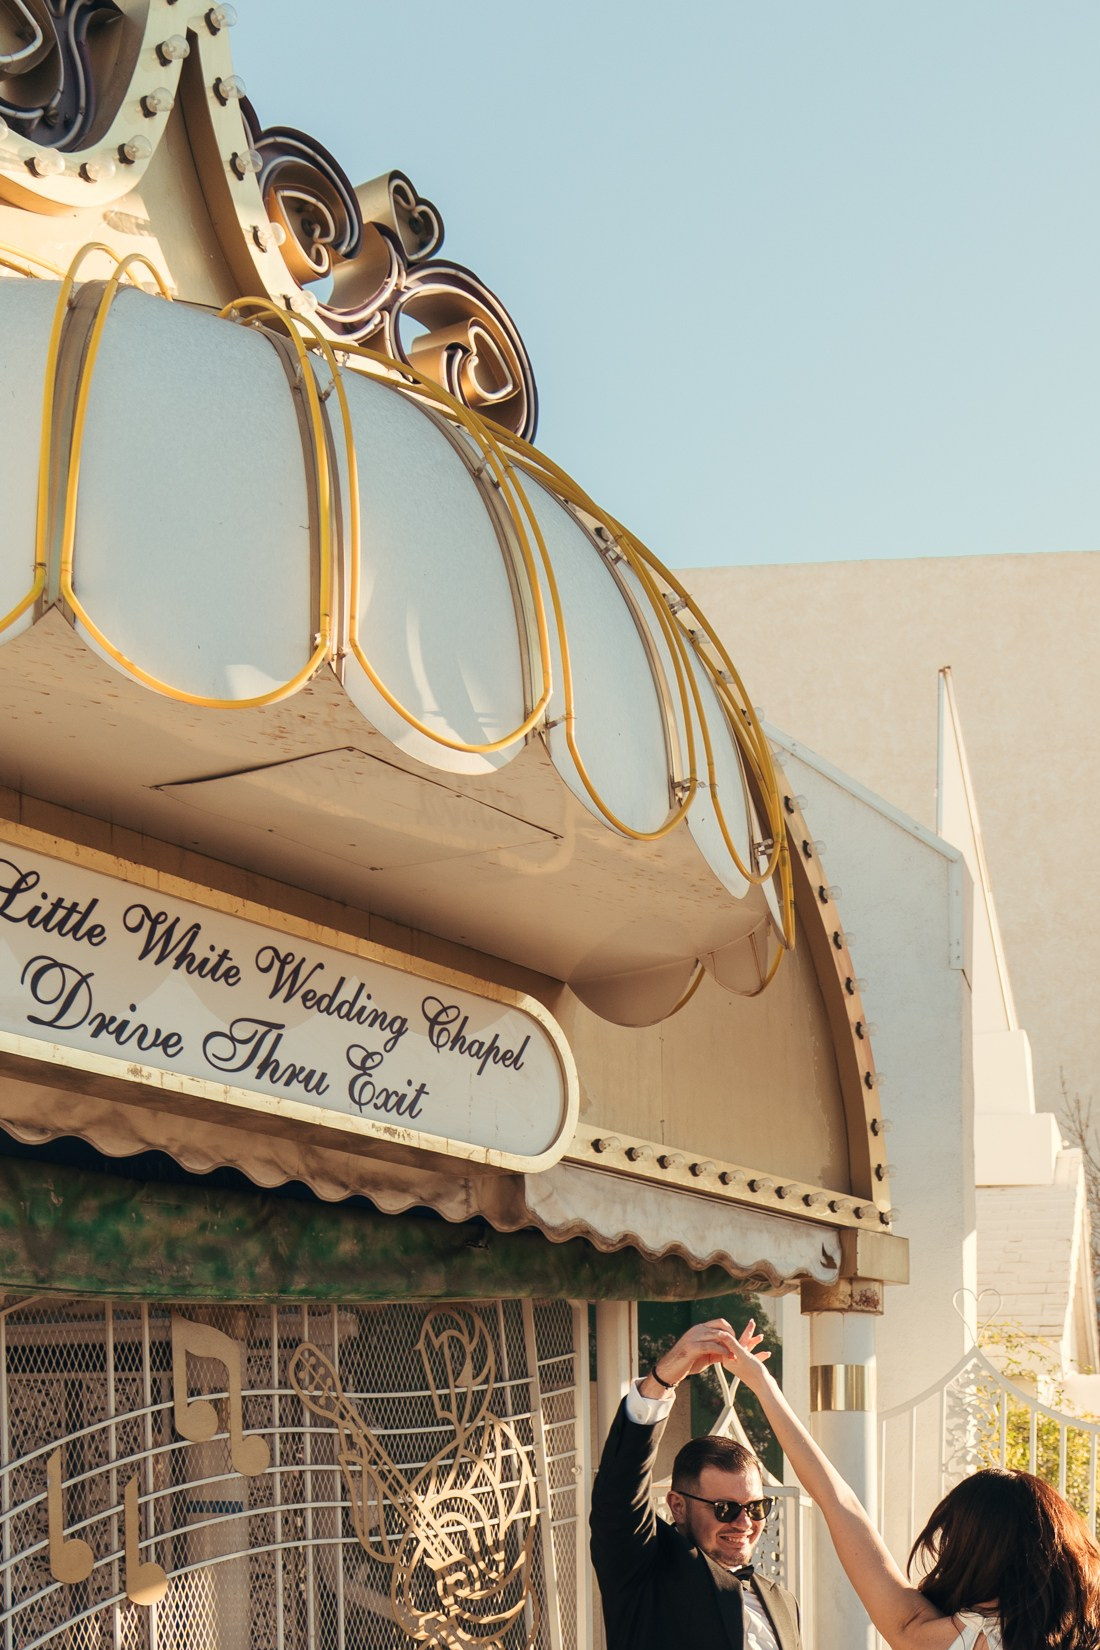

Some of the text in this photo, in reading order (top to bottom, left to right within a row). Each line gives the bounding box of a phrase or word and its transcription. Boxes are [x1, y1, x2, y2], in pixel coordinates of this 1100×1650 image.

[0, 858, 525, 1076] Little White Wedding Chapel
[20, 955, 430, 1120] Drive Thru Exit
